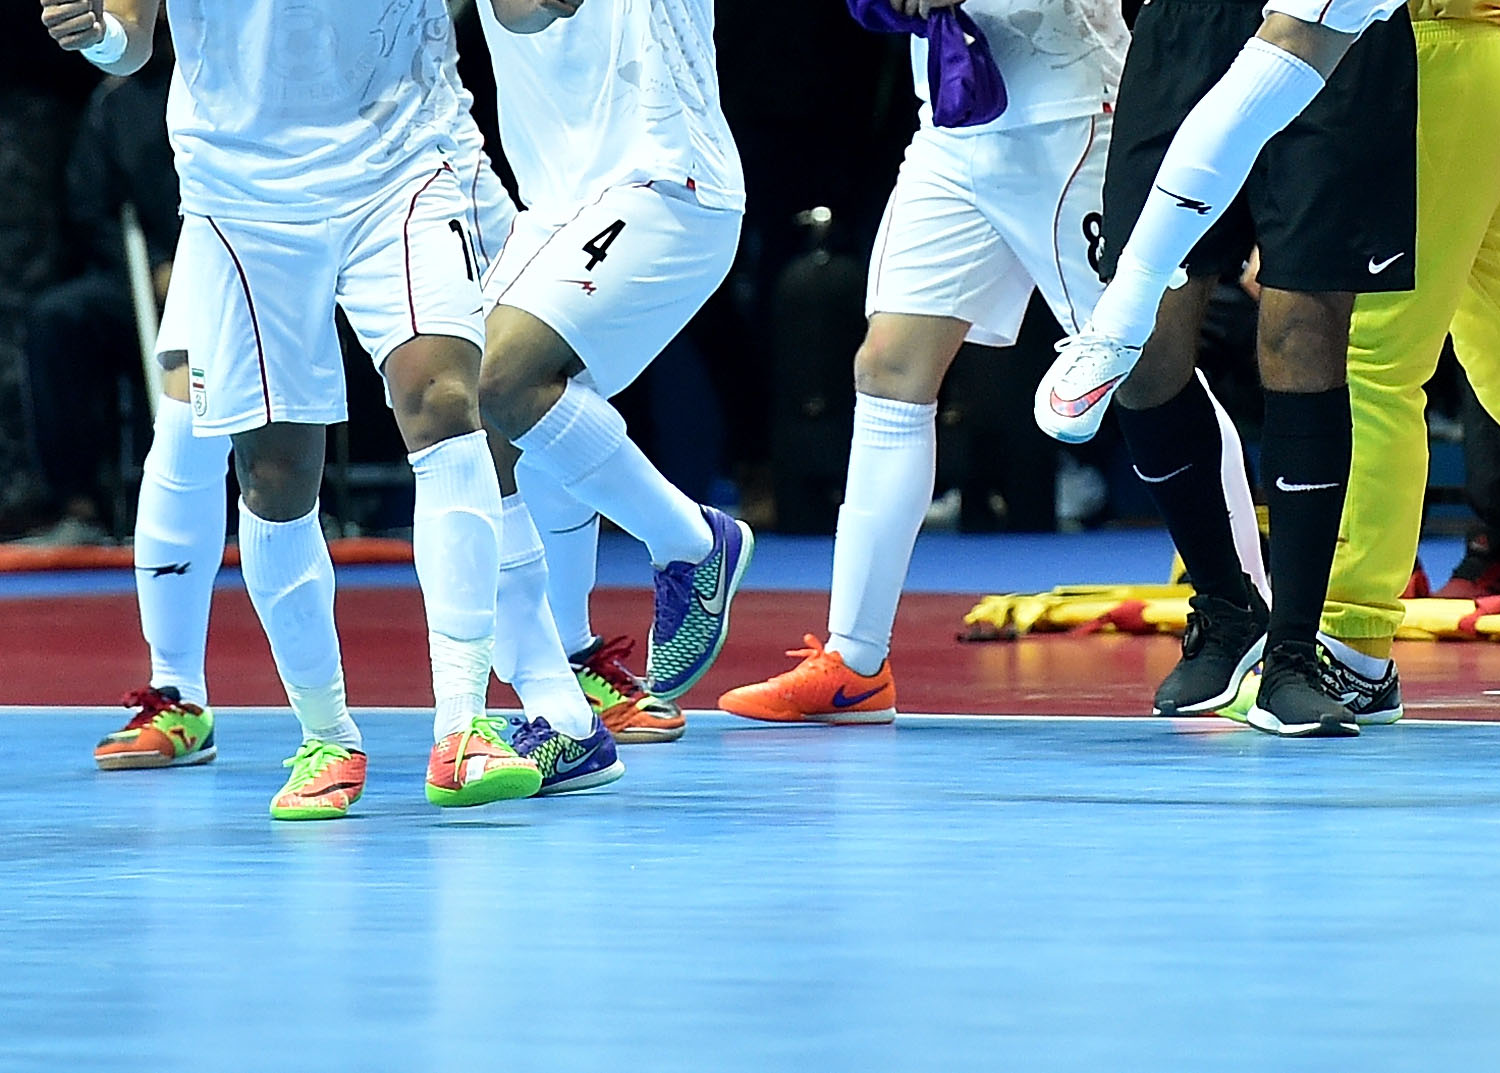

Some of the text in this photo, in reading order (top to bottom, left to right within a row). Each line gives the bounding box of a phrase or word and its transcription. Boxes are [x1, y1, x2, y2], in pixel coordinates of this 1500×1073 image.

[448, 219, 480, 282] 1
[582, 219, 627, 272] 4
[1082, 212, 1103, 274] 8
